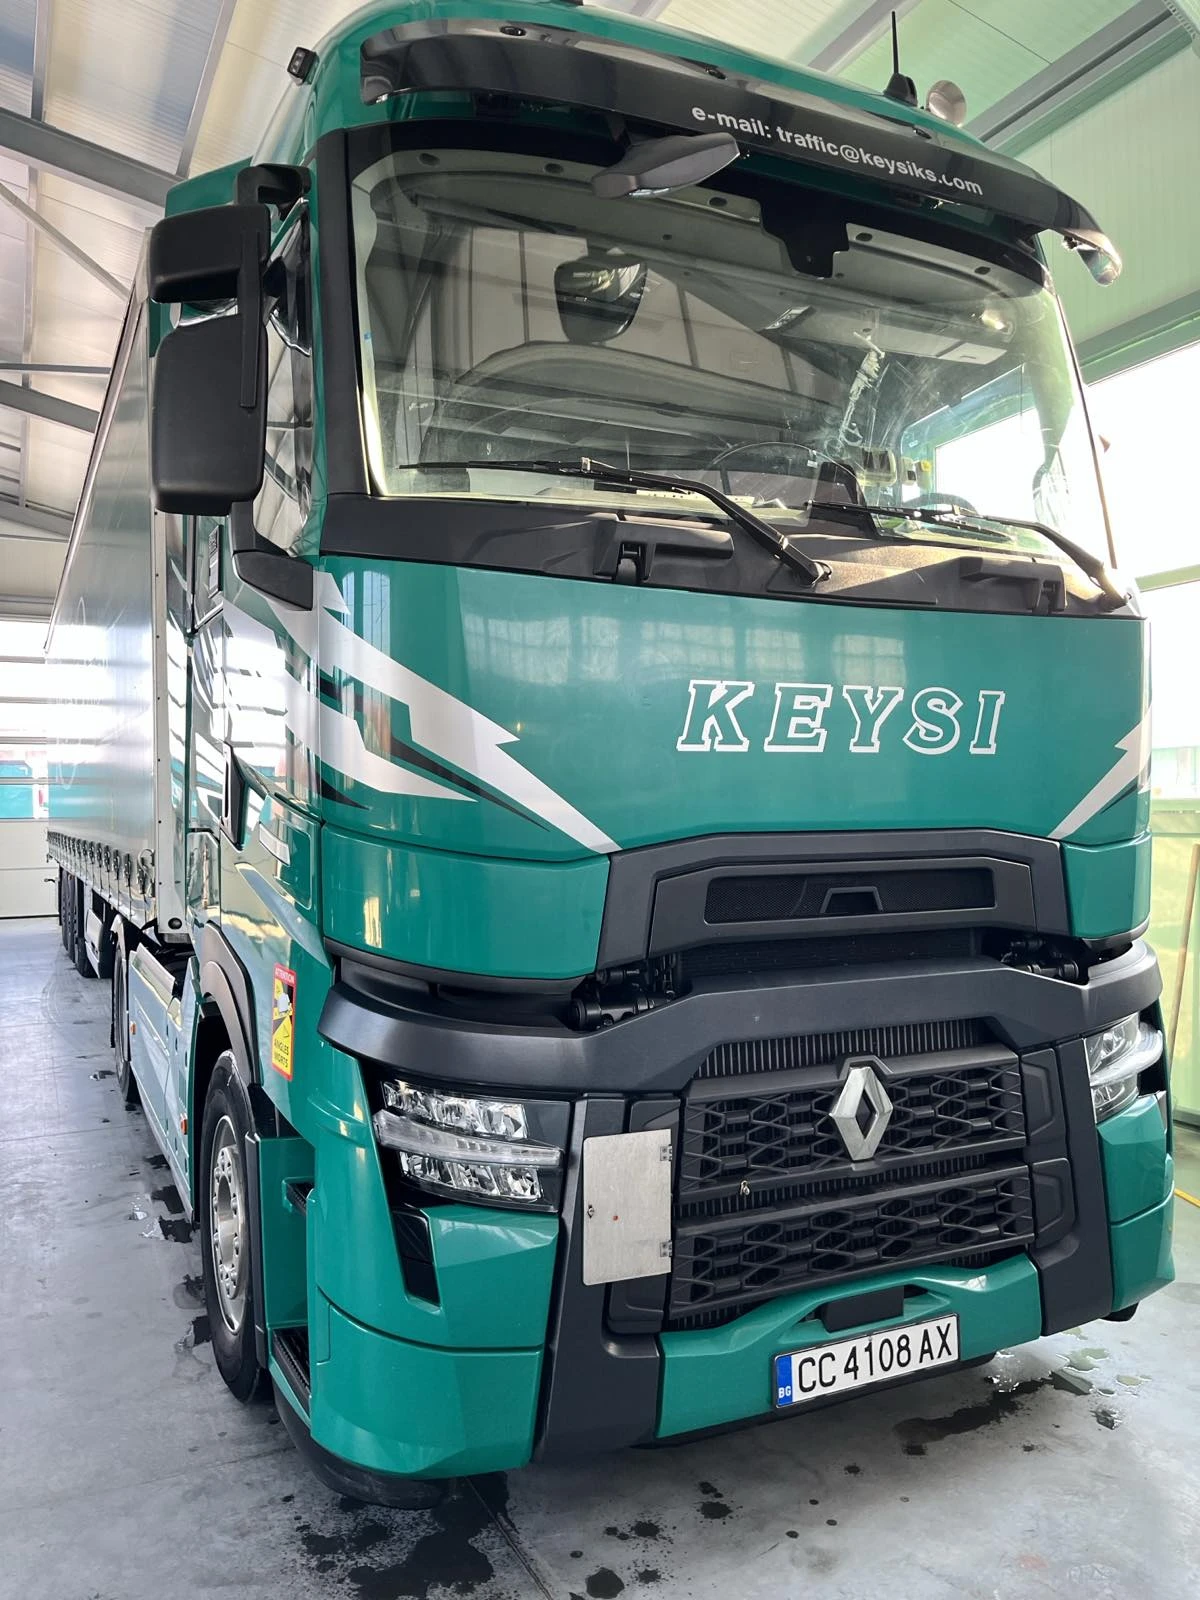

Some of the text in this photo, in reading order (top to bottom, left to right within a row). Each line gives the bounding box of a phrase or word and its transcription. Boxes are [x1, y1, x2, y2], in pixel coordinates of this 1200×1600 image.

[692, 106, 983, 196] e-mail: traffic@keysiks.com
[676, 680, 1005, 755] KEYSI
[778, 1385, 792, 1399] BG
[798, 1323, 952, 1393] CC 4108 AX
